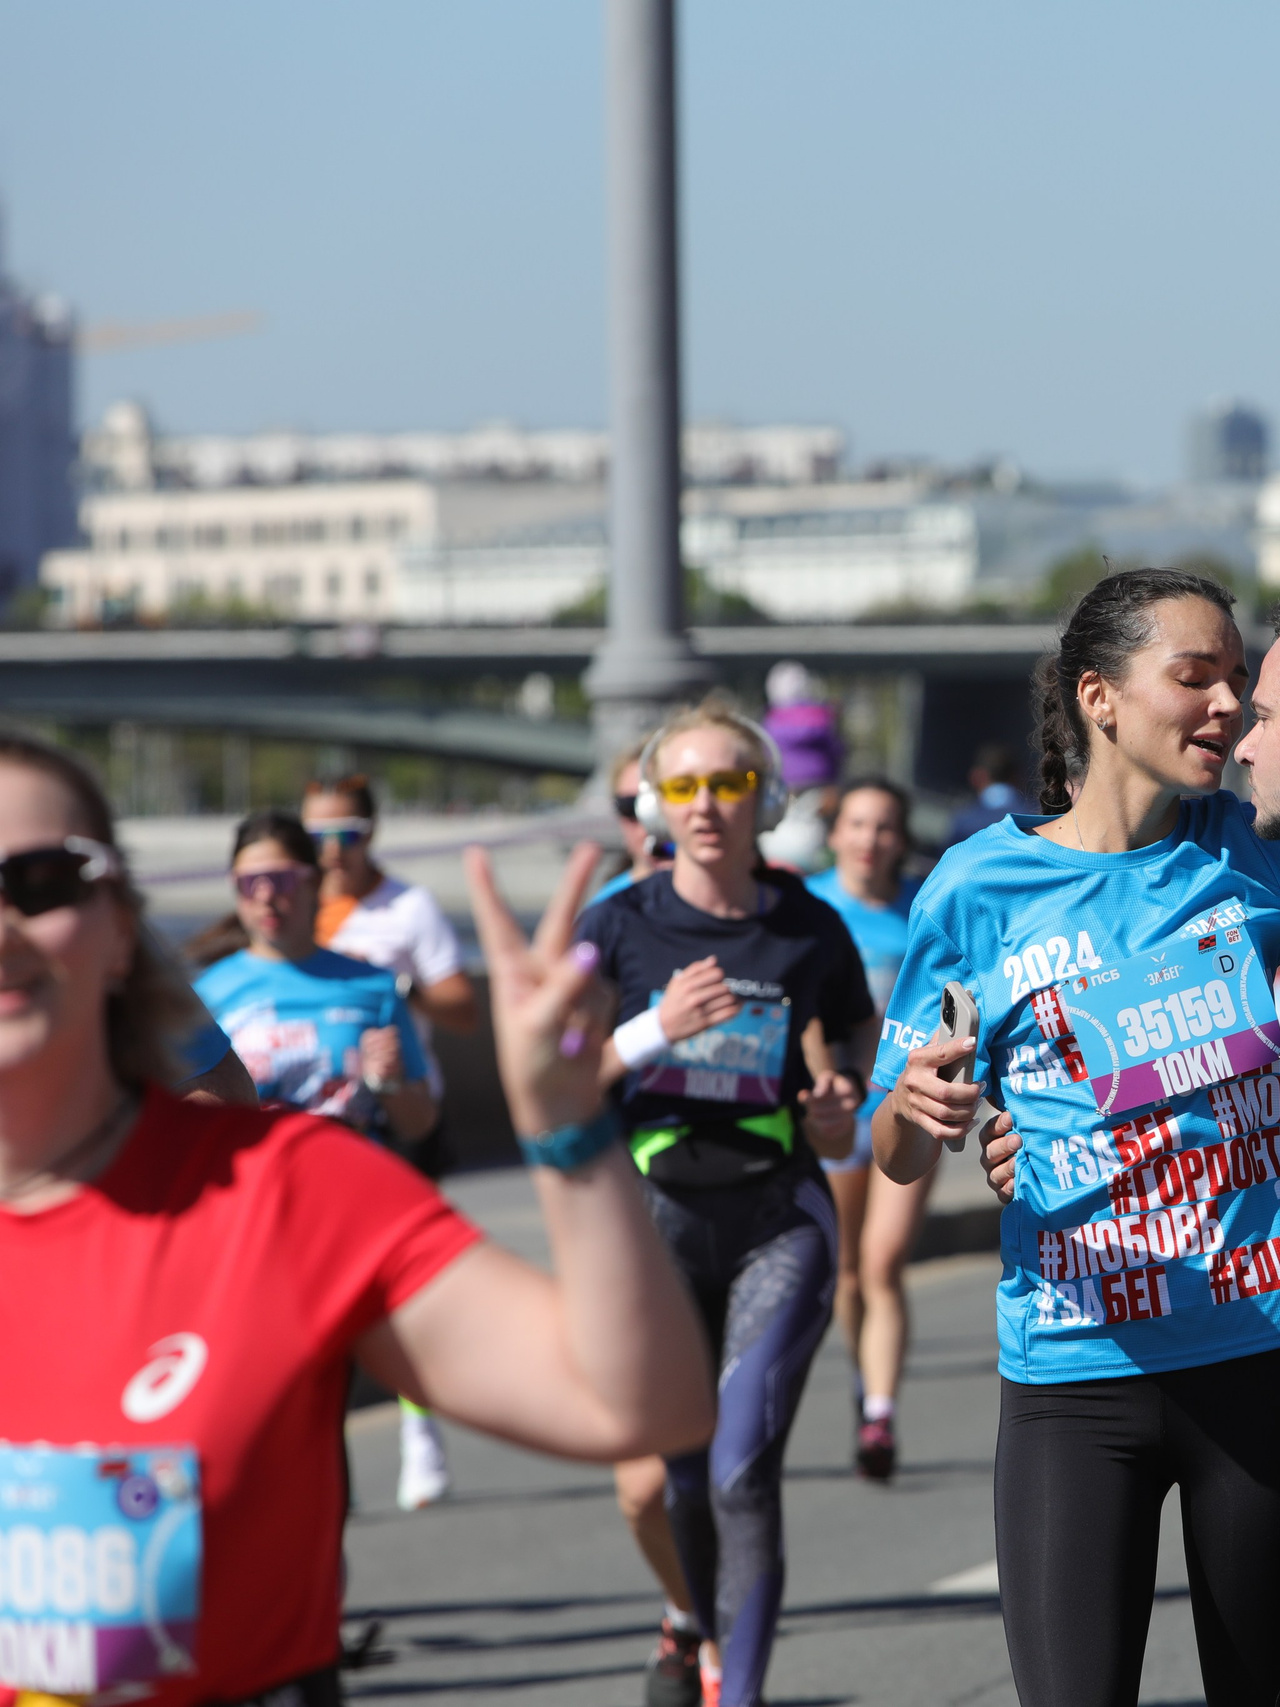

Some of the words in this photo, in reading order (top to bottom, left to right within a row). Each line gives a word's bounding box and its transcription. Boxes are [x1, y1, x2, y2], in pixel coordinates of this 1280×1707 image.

[1226, 929, 1238, 938] FON
[1228, 935, 1240, 944] BET
[1003, 930, 1103, 1006] 2024
[1090, 968, 1121, 987] ПСБ
[1219, 955, 1234, 973] D
[881, 1018, 927, 1051] ПСБ
[1117, 980, 1237, 1058] 35159
[1050, 1108, 1177, 1190] #ЗАБЕГ
[1040, 1200, 1225, 1279] #ЛЮБОВЬ
[1037, 1266, 1168, 1326] #ЗАБЕГ
[0, 1524, 137, 1615] 086
